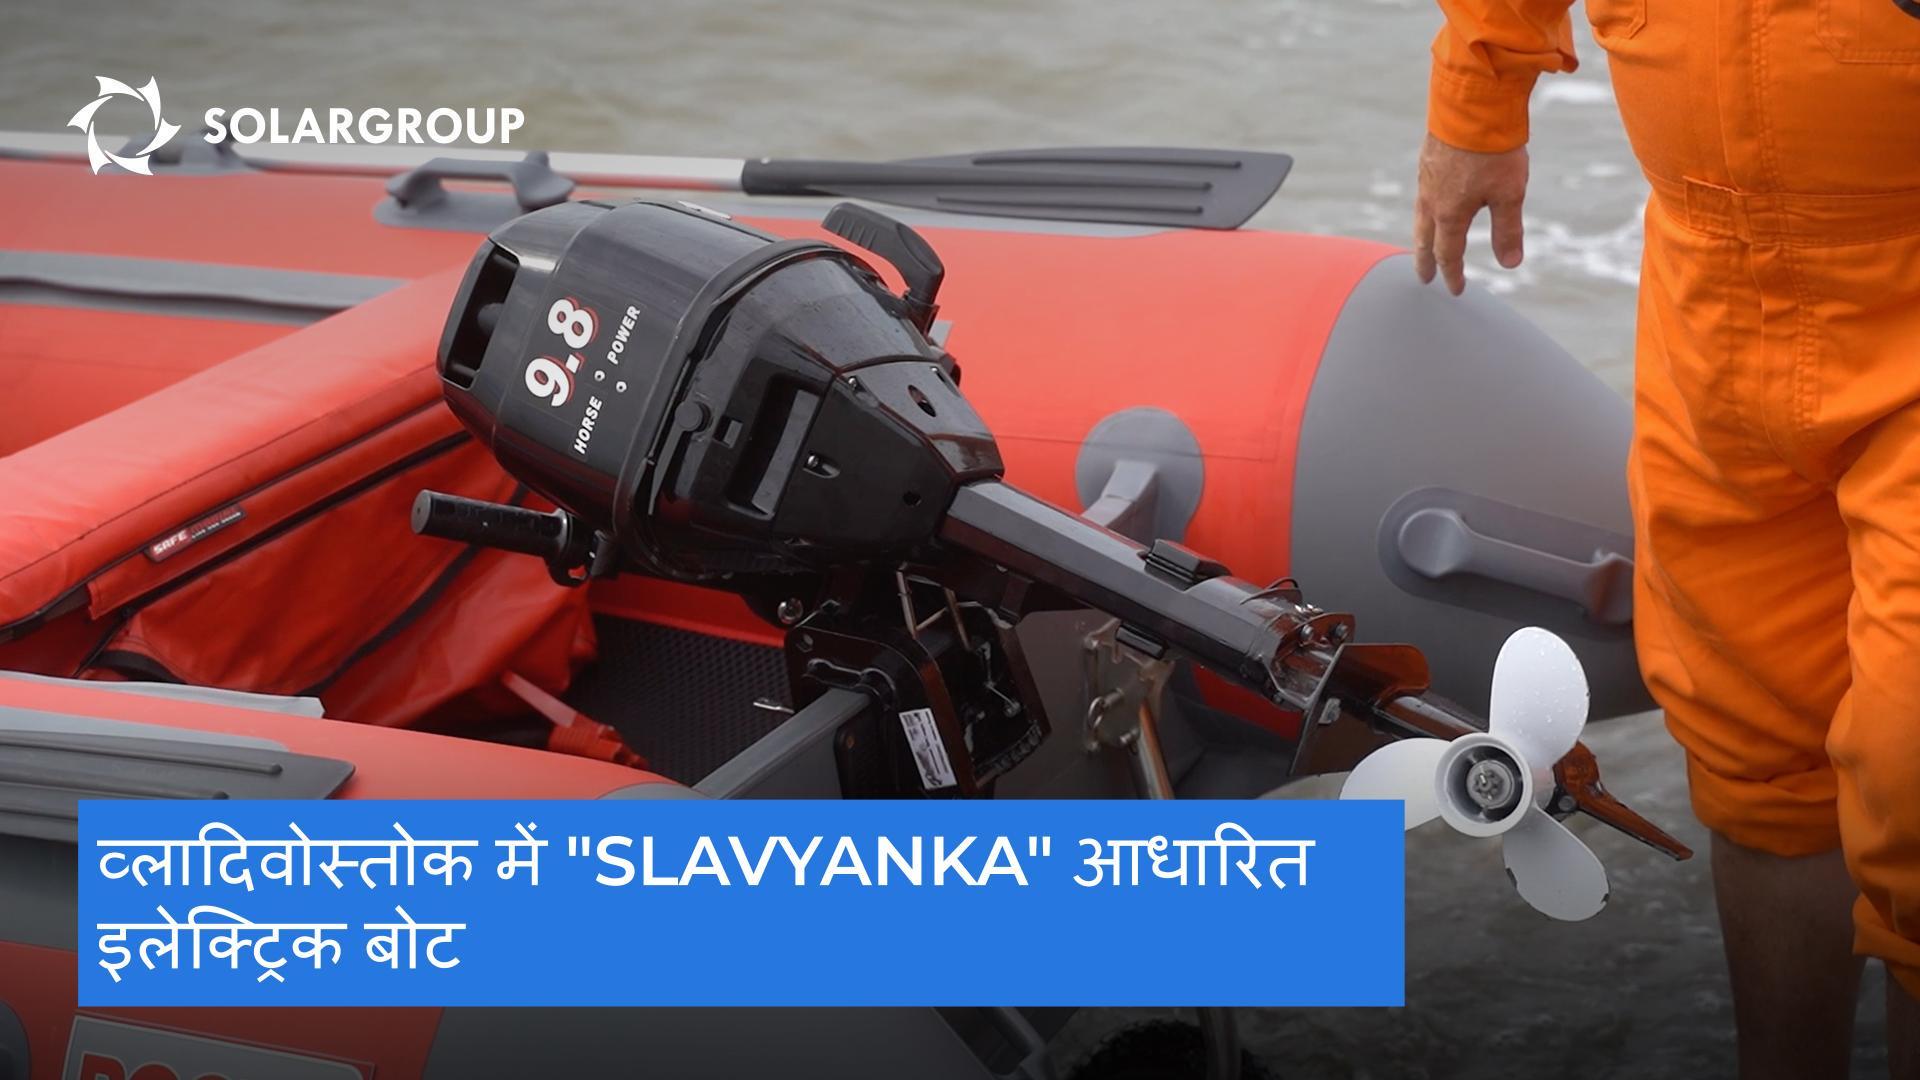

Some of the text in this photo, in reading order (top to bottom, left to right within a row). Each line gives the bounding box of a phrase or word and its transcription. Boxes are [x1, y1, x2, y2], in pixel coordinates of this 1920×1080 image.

[525, 297, 600, 407] 9.8
[573, 305, 641, 455] HORSE POWER
